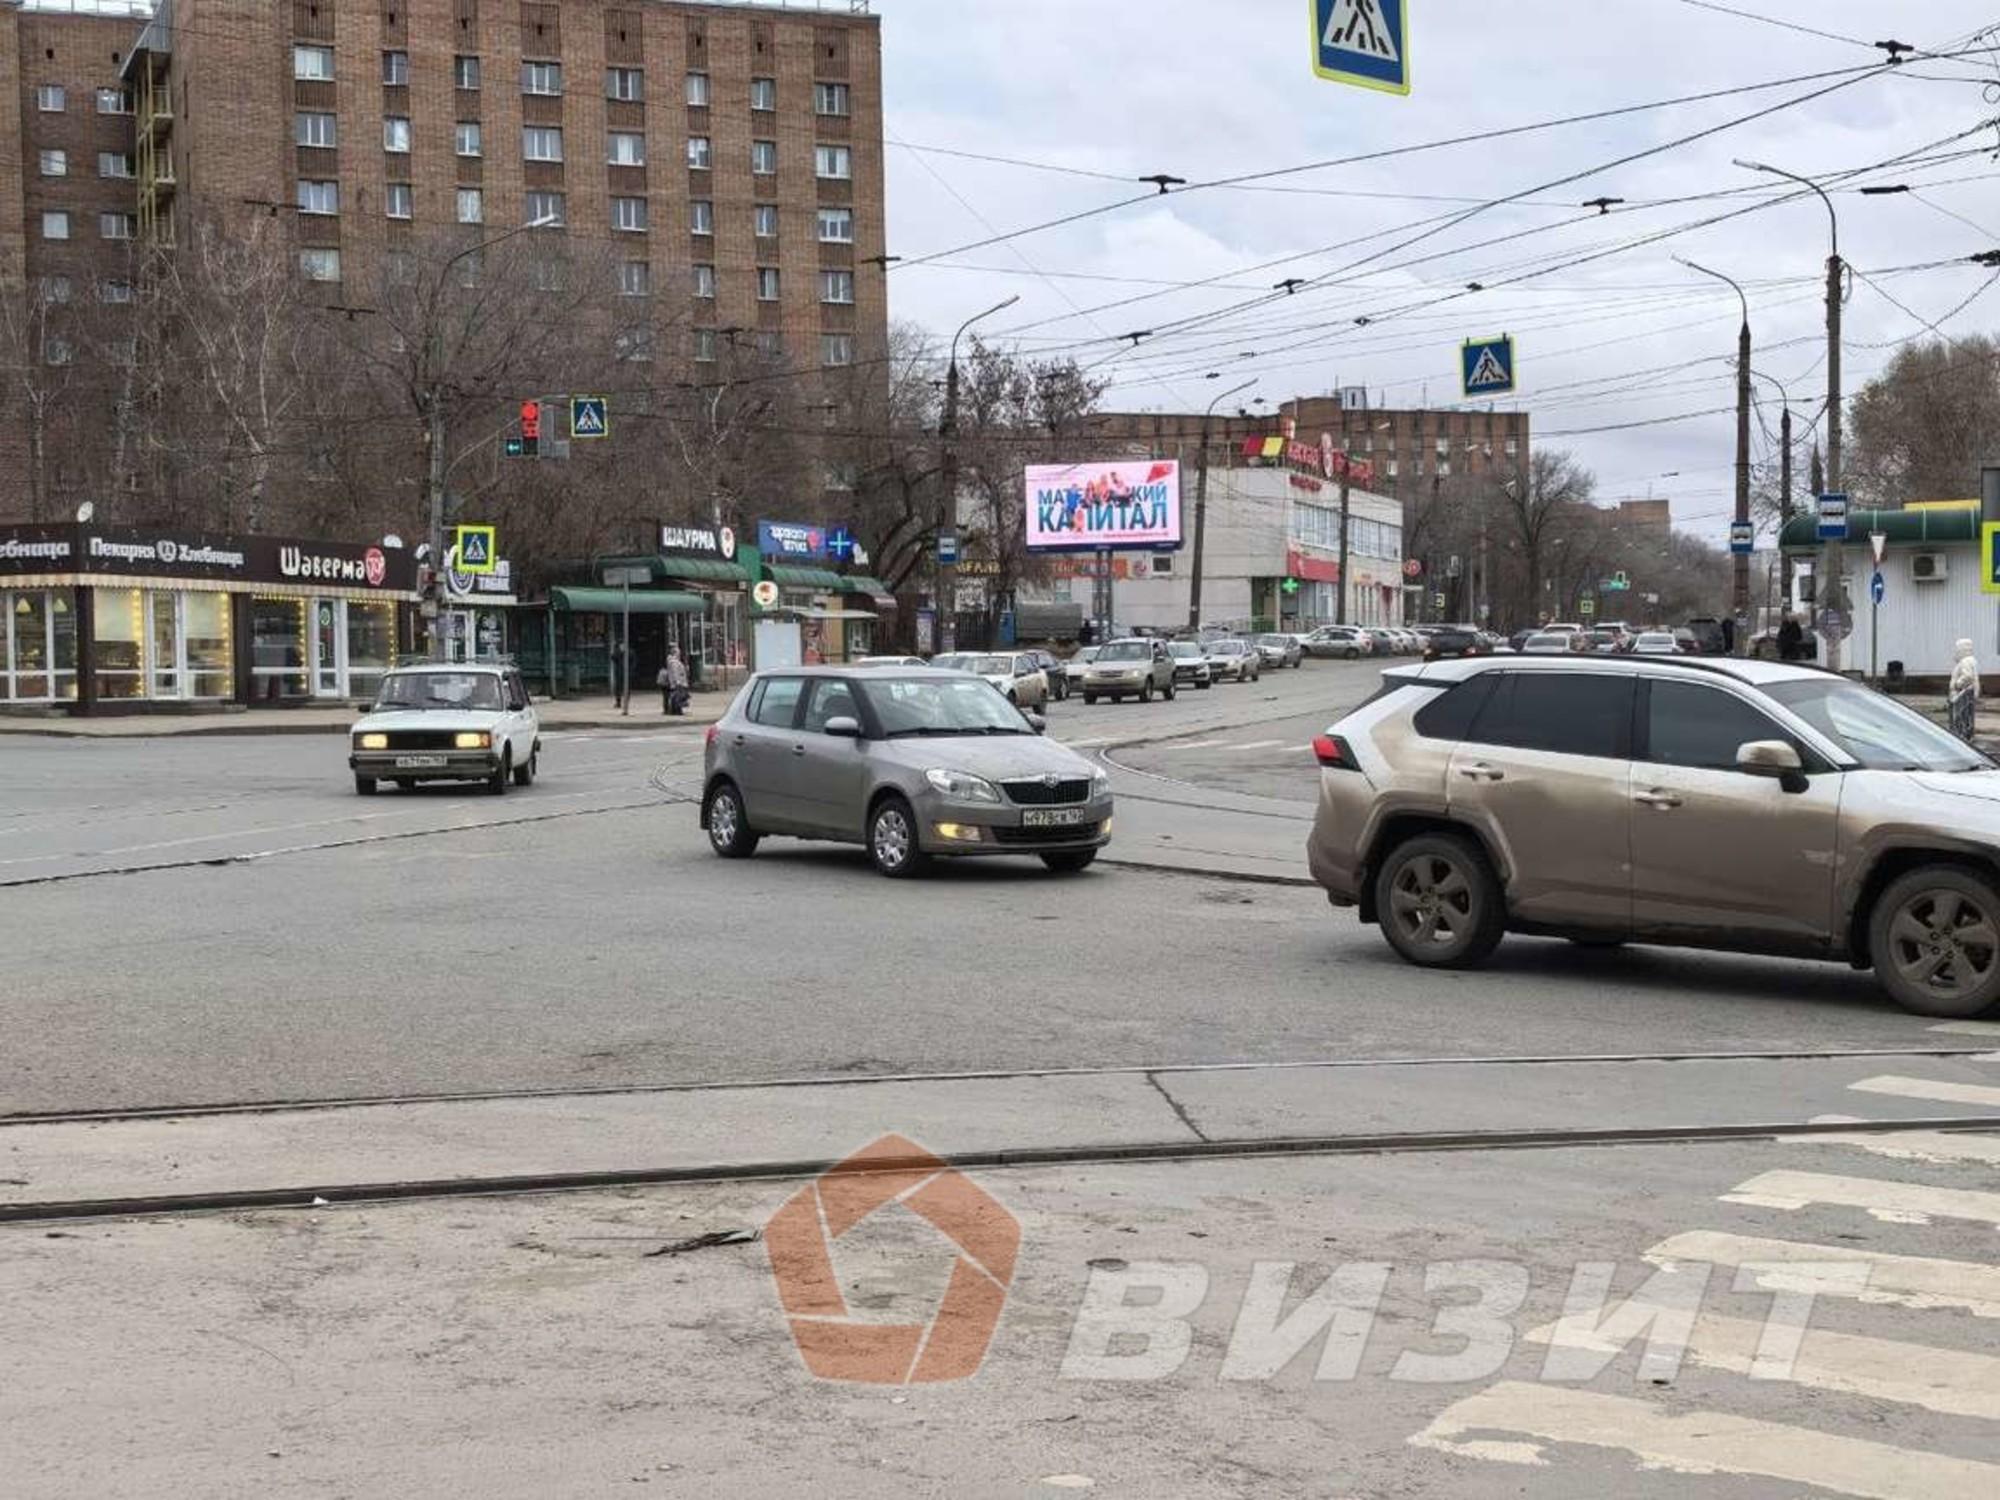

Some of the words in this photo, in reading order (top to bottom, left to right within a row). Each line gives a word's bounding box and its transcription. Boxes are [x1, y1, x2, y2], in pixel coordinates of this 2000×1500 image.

[90, 537, 156, 563] Пекарня
[178, 544, 244, 568] Хлебница
[663, 527, 716, 550] ШАУРМА
[280, 546, 366, 580] Шаверма
